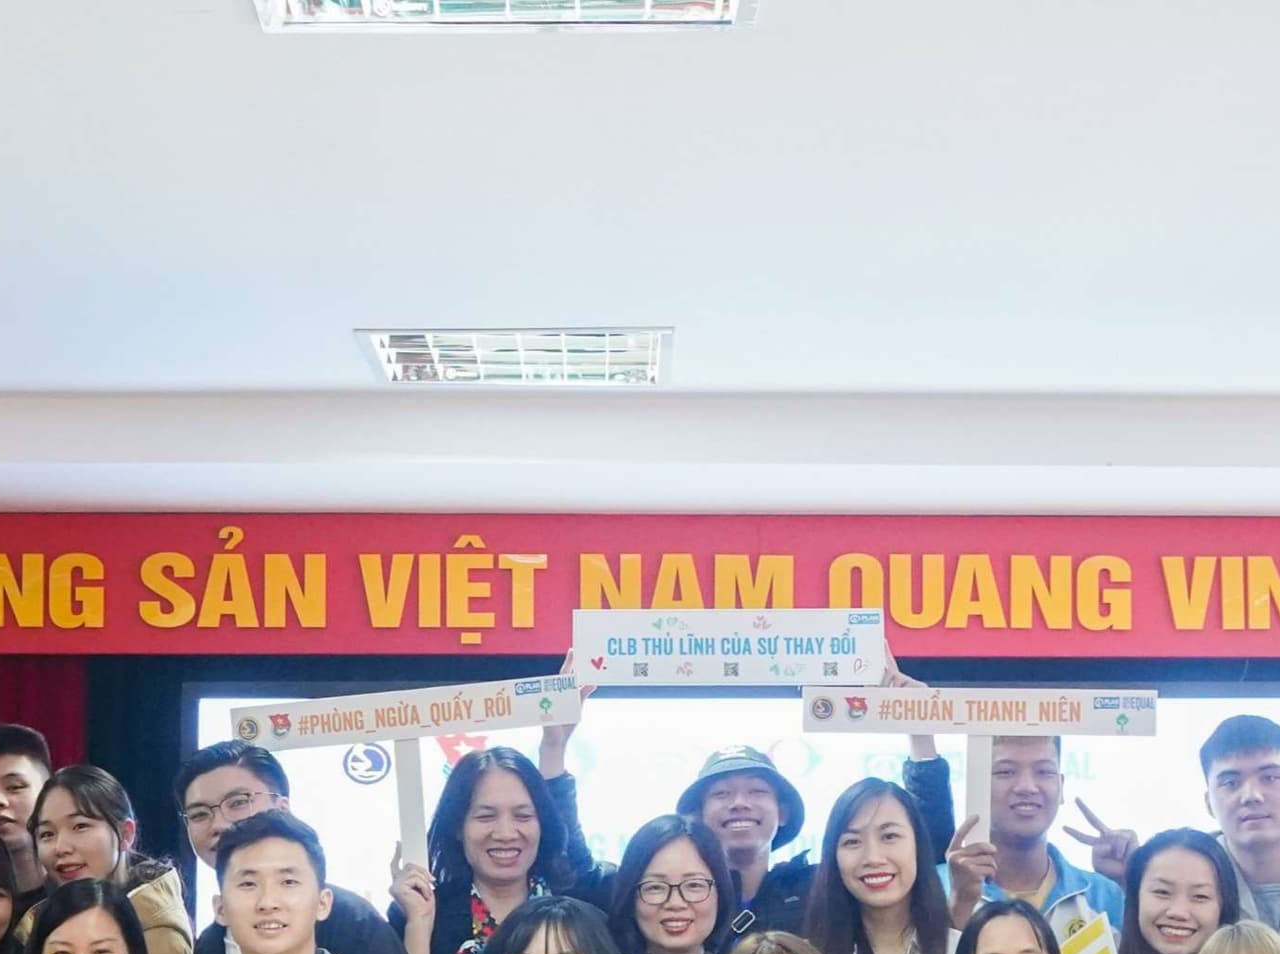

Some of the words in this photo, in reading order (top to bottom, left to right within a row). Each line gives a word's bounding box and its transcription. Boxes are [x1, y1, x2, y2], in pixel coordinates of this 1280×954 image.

[137, 525, 327, 628] SẢN
[357, 533, 548, 645] VIỆT
[579, 552, 795, 609] NAM
[827, 552, 1132, 630] QUANG
[607, 637, 637, 657] CLB
[641, 631, 674, 656] THỦ
[721, 631, 752, 656] CỦA
[757, 633, 781, 660] SỰ
[784, 637, 825, 656] THAY
[830, 628, 857, 656] ĐỔI
[877, 690, 1082, 726] #CHUẨN_THANH_NIÊN
